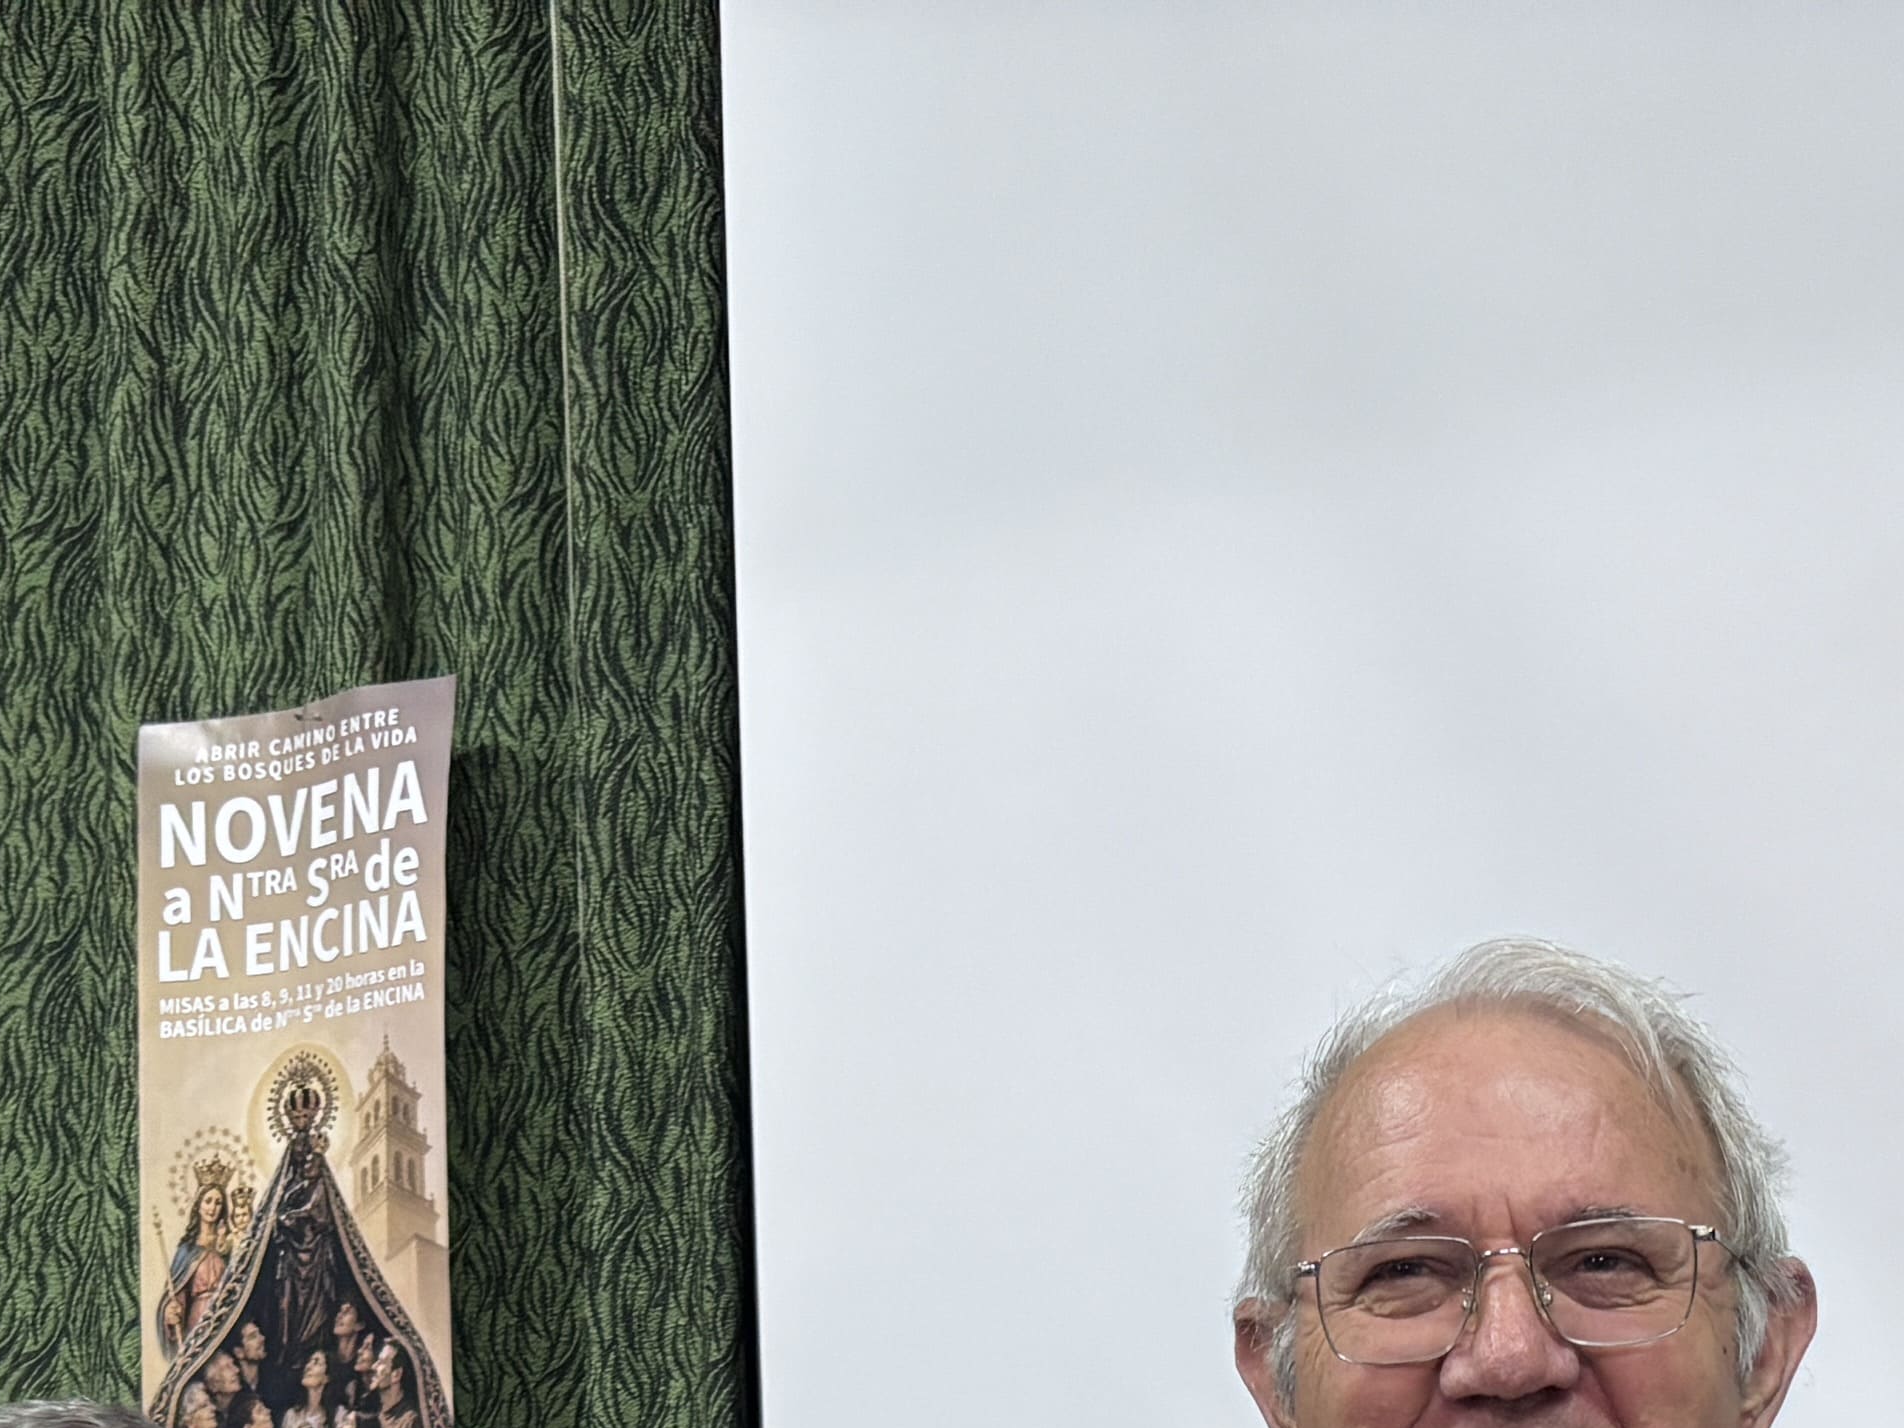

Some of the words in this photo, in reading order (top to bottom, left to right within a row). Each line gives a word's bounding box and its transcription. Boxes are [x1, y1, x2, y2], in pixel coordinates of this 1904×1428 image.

[174, 766, 215, 786] LOS
[222, 750, 316, 781] BOSQUES
[321, 743, 340, 766] DE
[344, 736, 365, 757] LA
[370, 725, 418, 750] VIDA
[195, 740, 260, 764] ABRIR
[268, 724, 336, 756] CAMINO
[339, 708, 400, 737] ENTRE
[158, 759, 429, 869] NOVENA
[162, 886, 192, 926] a
[363, 837, 420, 892] de
[157, 927, 230, 983] LA
[244, 889, 427, 977] ENCINA
[159, 996, 216, 1016] MISAS
[218, 998, 228, 1012] a
[233, 993, 258, 1010] las
[296, 984, 312, 1001] 11
[314, 983, 325, 1001] y
[326, 976, 344, 994] 20
[344, 970, 386, 990] horas
[387, 965, 407, 981] en
[409, 959, 425, 977] la
[159, 1012, 247, 1039] BASÍLICA
[250, 1015, 273, 1033] de
[324, 1000, 343, 1019] de
[346, 995, 361, 1013] la
[363, 982, 425, 1011] ENCINA
